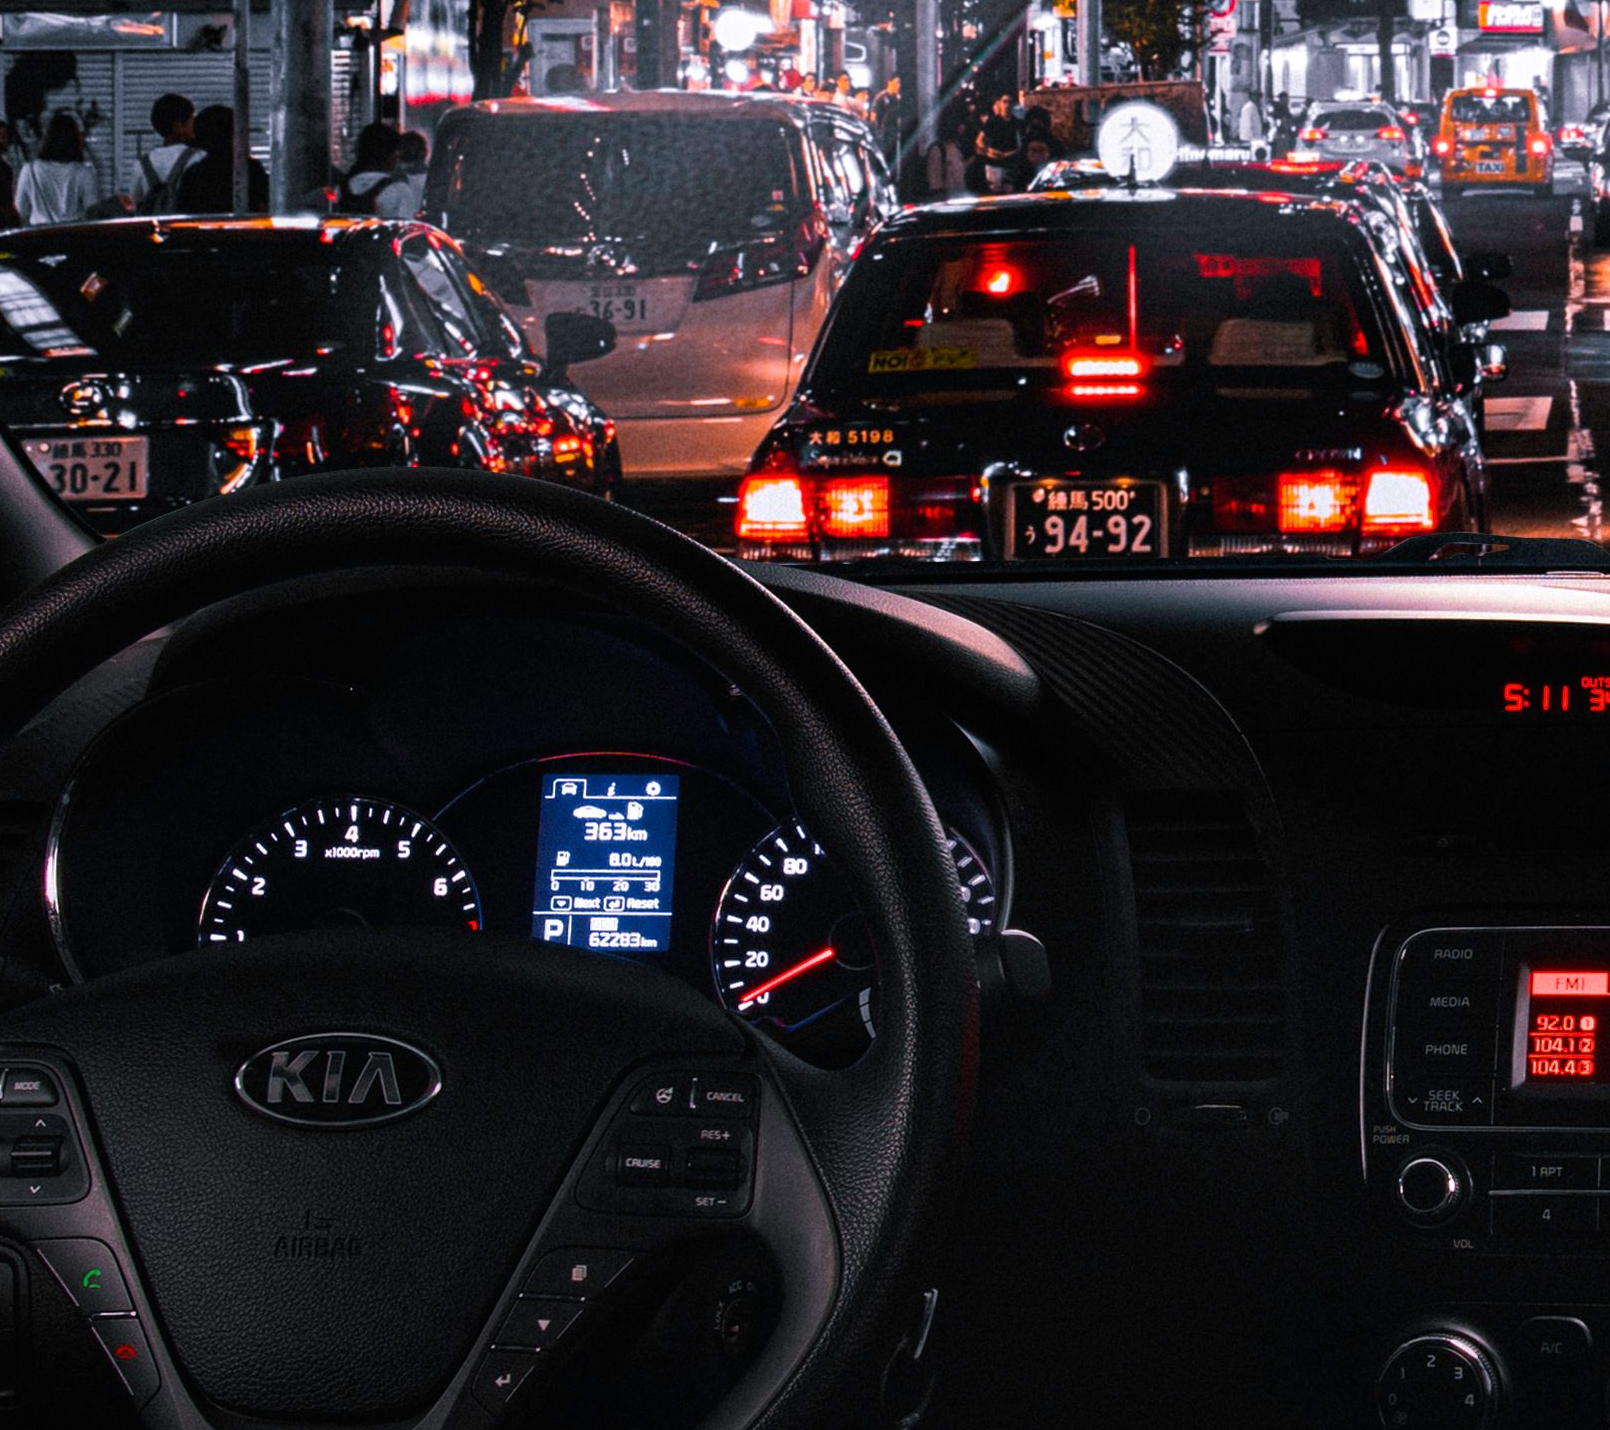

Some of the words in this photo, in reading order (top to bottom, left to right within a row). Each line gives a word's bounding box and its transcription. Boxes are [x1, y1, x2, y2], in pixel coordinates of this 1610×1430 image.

[1478, 163, 1504, 173] TAXI
[847, 429, 894, 445] 5198
[49, 461, 137, 495] 30-21
[1047, 490, 1089, 511] 練馬
[1091, 490, 1130, 511] 500
[1044, 515, 1152, 554] 94-92
[1504, 683, 1569, 712] 5:11
[344, 825, 359, 843] 4
[584, 821, 648, 841] 363km
[294, 840, 308, 858] 3
[324, 846, 381, 859] x1000rpm
[397, 840, 411, 858] 5
[782, 857, 808, 875] 80
[251, 877, 266, 896] 2
[433, 878, 448, 896] 6
[550, 881, 560, 892] 0
[580, 881, 595, 892] 10
[612, 881, 630, 892] 20
[643, 881, 661, 892] 30
[759, 884, 784, 901] 60
[573, 897, 601, 910] Next
[626, 897, 660, 910] Reset
[543, 919, 565, 941] P
[745, 915, 770, 933] 40
[236, 929, 245, 942] 1
[589, 931, 658, 948] 62283km
[744, 951, 769, 968] 20
[1433, 948, 1474, 960] RADIO
[1554, 977, 1586, 990] FM1
[1429, 996, 1471, 1008] MEDIA
[1537, 1016, 1574, 1031] 92.0
[1425, 1044, 1469, 1055] PHONE
[1534, 1038, 1575, 1053] 104.1
[1532, 1060, 1575, 1075] 104.4
[266, 1049, 402, 1105] KIA
[14, 1081, 41, 1091] MODE
[706, 1091, 744, 1103] CANCEL
[1428, 1090, 1460, 1101] SEEK
[1423, 1101, 1464, 1112] TRACK
[1372, 1134, 1410, 1144] POWER
[625, 1157, 662, 1169] CRUISE
[1541, 1208, 1552, 1221] 4
[273, 1236, 362, 1258] AIRBAG
[1453, 1239, 1475, 1249] VOL
[1541, 1342, 1562, 1354] A/C
[1426, 1354, 1436, 1368] 2
[1453, 1366, 1464, 1380] 3
[1464, 1394, 1475, 1407] 4
